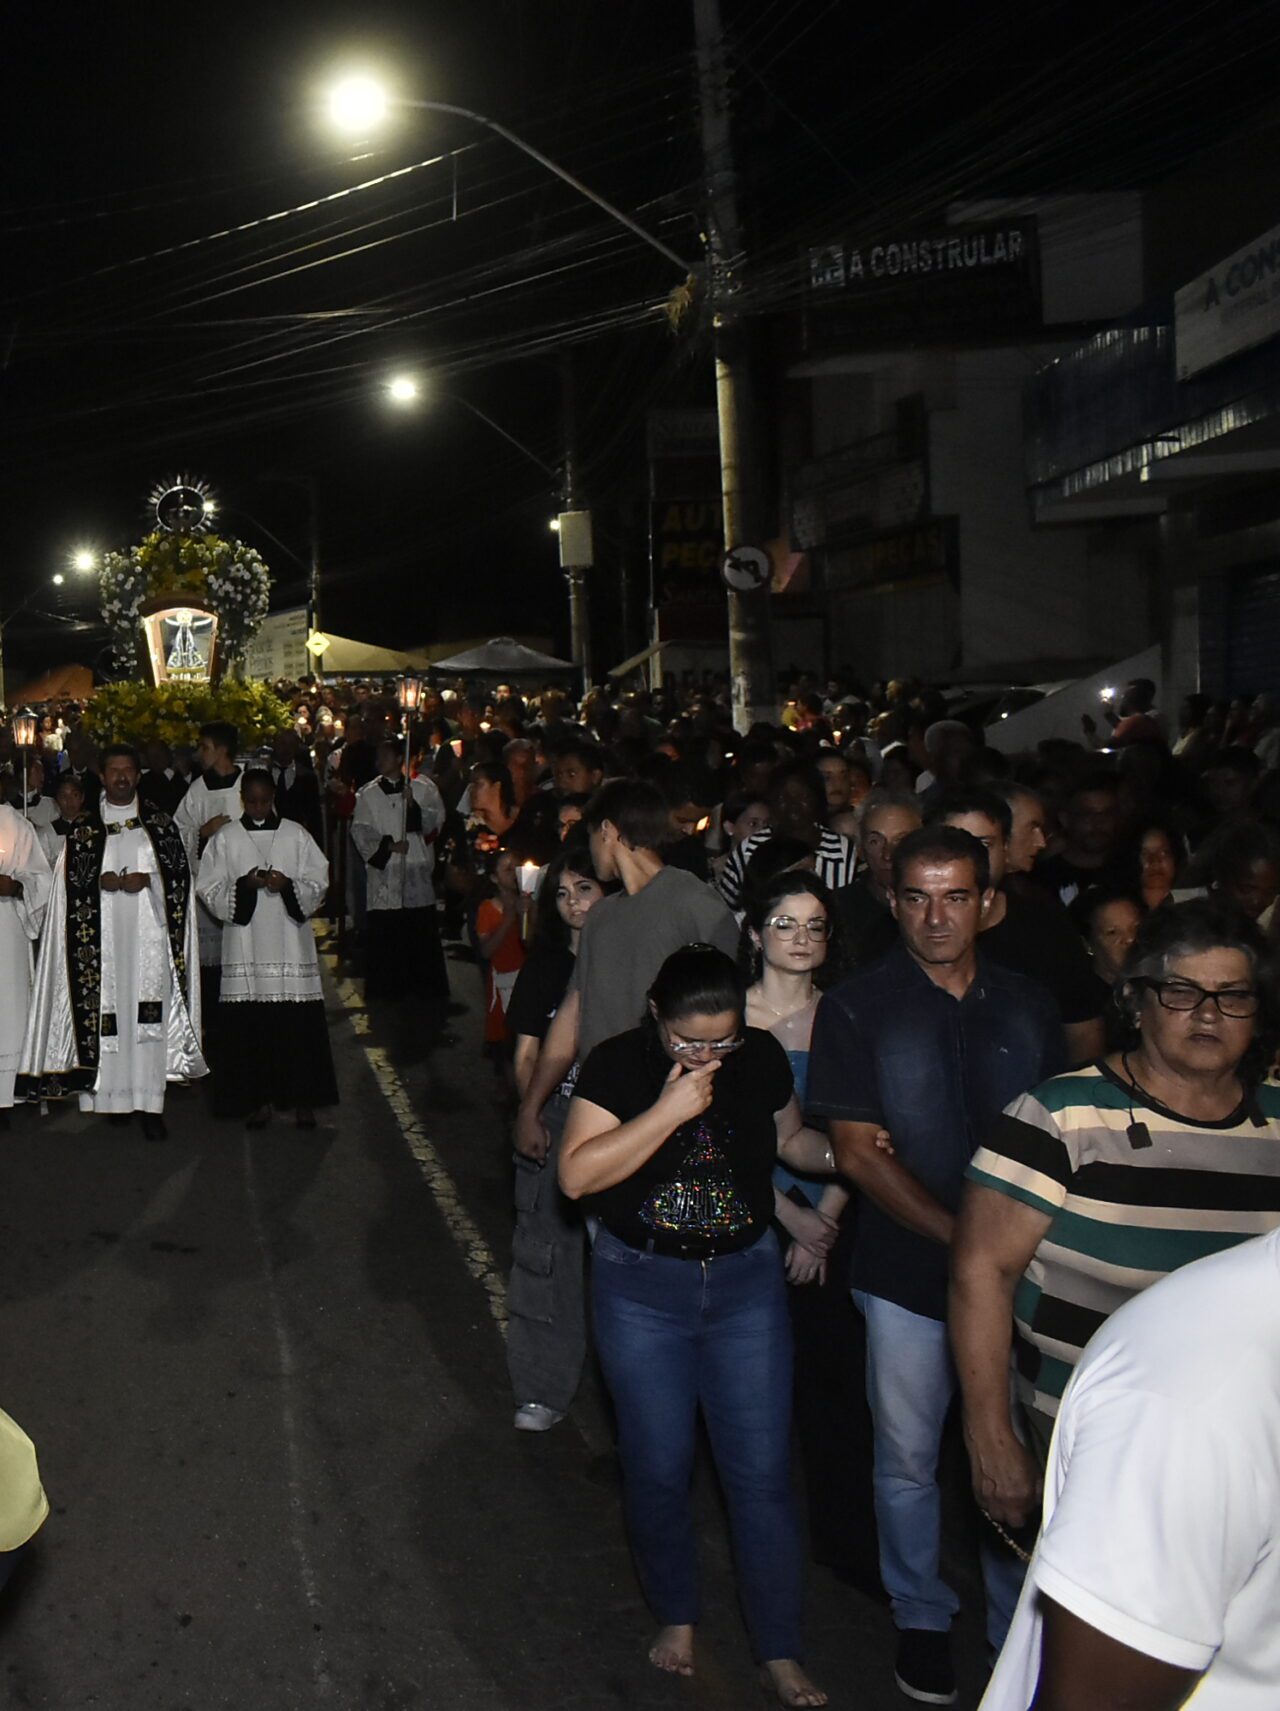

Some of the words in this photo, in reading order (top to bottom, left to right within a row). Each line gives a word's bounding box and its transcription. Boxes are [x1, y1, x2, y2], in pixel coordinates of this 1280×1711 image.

[869, 230, 1024, 278] CONSTRULAR
[1204, 278, 1220, 312] A
[1226, 238, 1280, 297] CON
[661, 503, 722, 533] AUT
[661, 541, 722, 572] PEÇ
